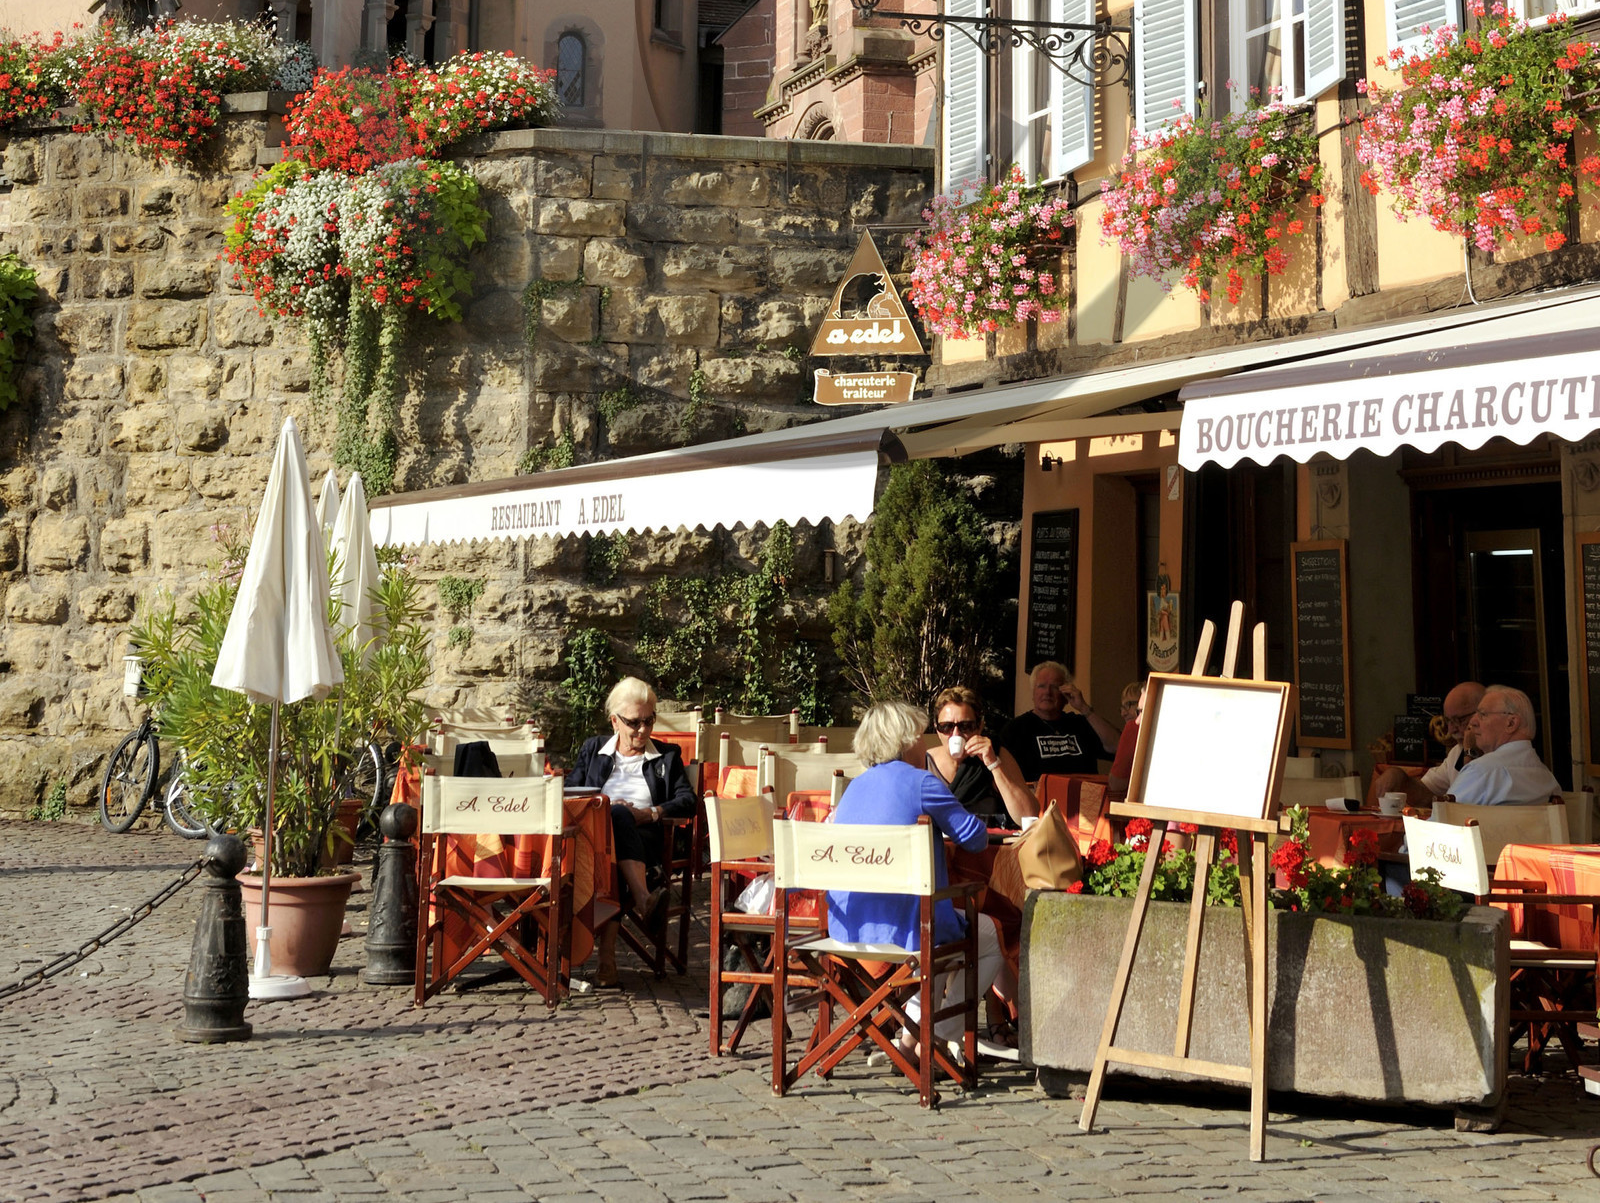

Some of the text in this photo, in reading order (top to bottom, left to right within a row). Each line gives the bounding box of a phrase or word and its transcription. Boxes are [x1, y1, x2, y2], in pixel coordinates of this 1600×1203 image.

[826, 320, 906, 344] a edel
[834, 375, 896, 387] charcuterie
[842, 388, 887, 399] traiteur
[1196, 397, 1384, 454] BOUCHERIE
[491, 493, 626, 531] RESTAURANT A. EDEL
[456, 796, 530, 813] A. Edel
[811, 845, 894, 865] A. Edel
[1425, 842, 1463, 865] A. Edel
